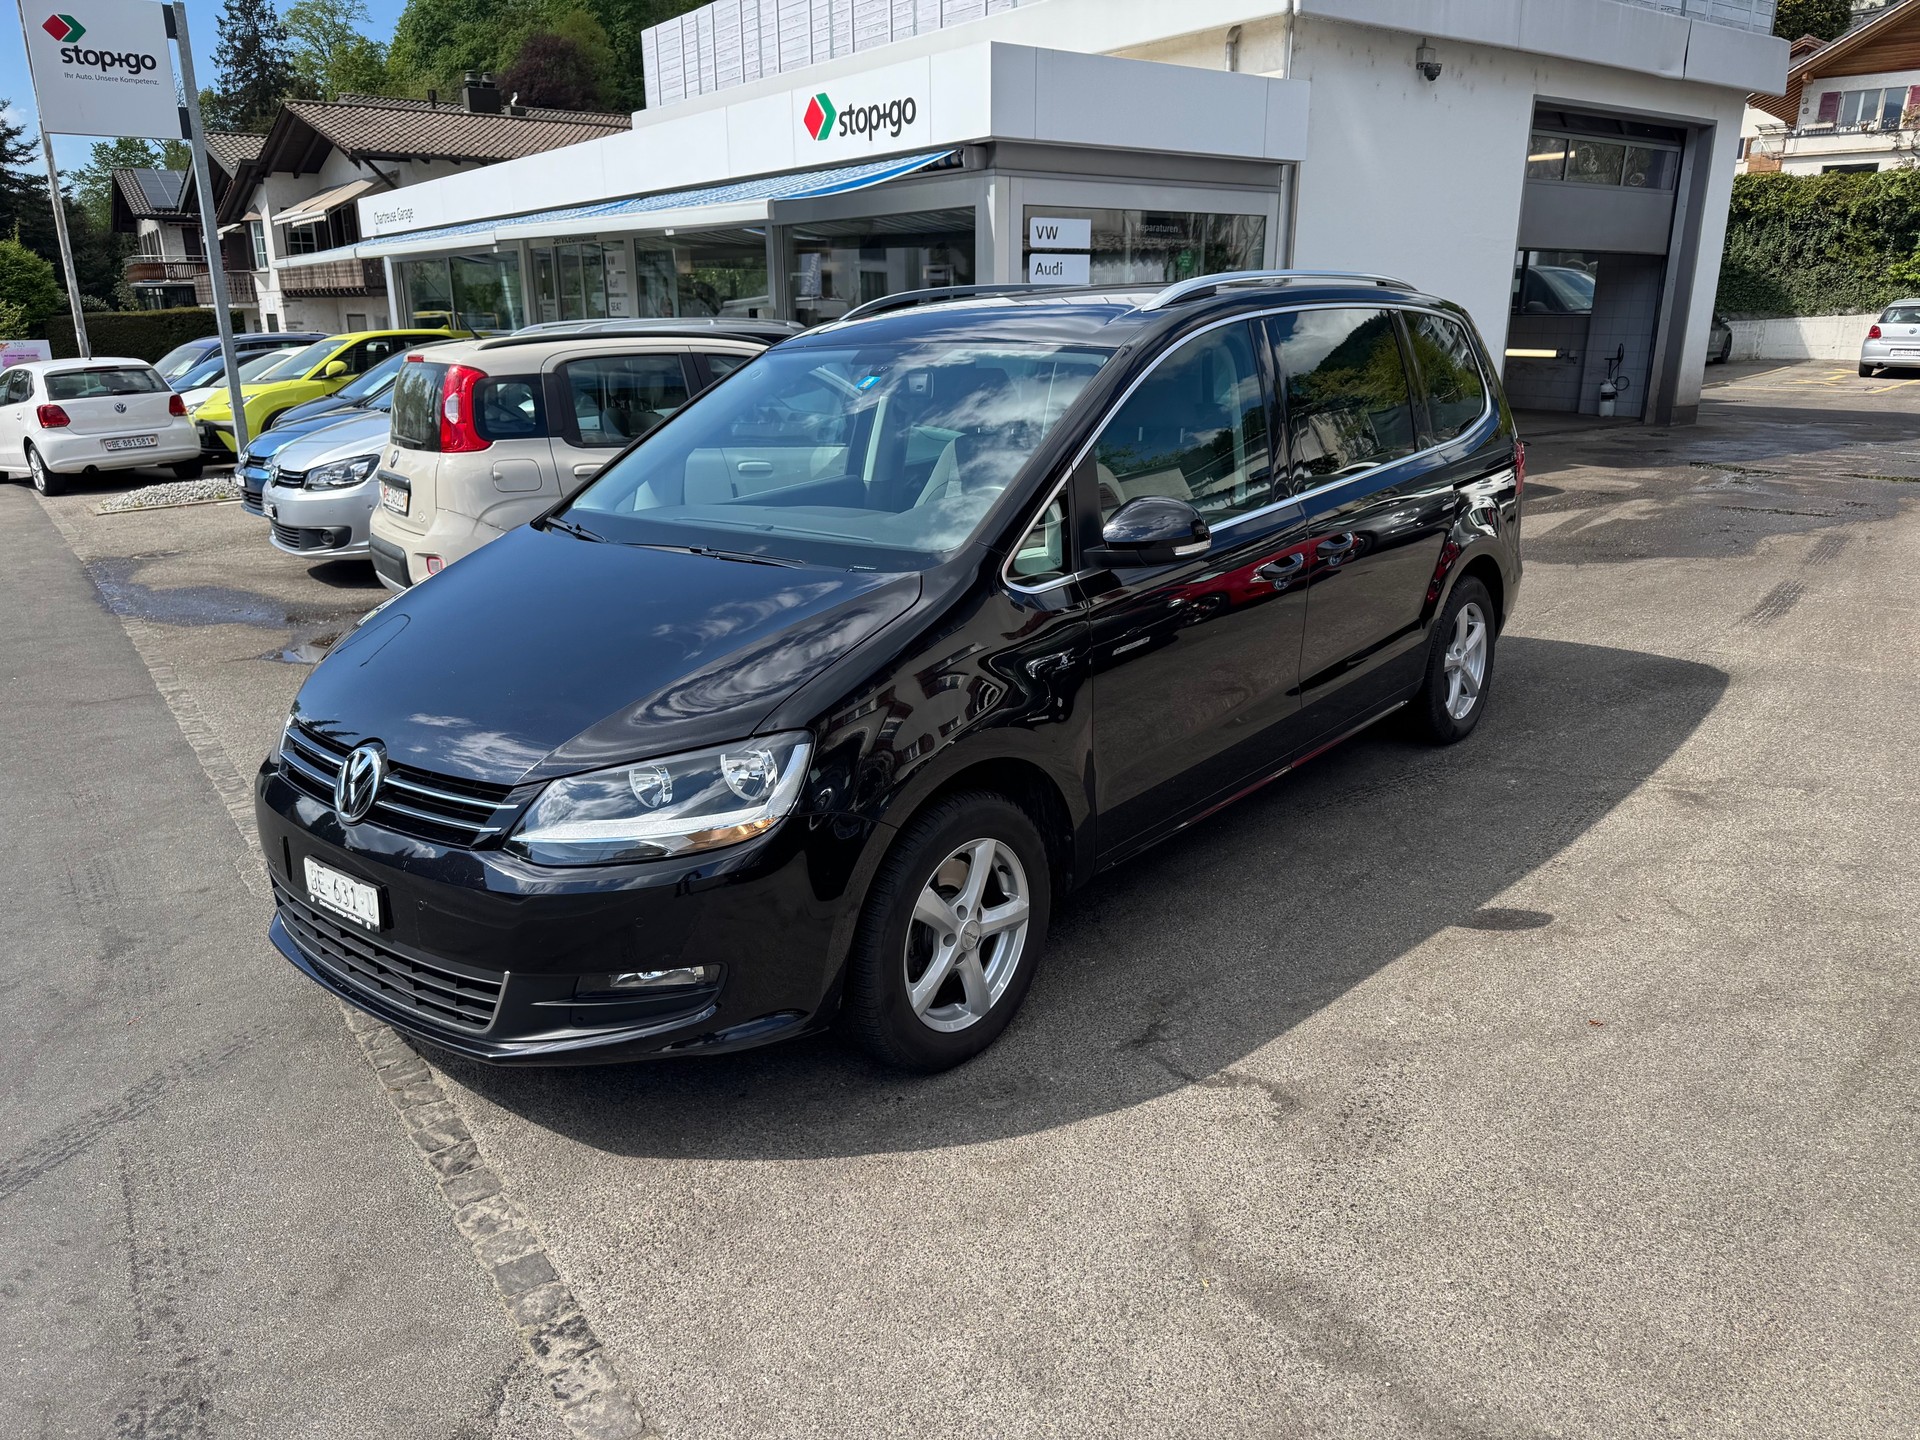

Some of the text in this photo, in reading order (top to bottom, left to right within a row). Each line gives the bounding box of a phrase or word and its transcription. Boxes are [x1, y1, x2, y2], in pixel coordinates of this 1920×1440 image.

[60, 45, 156, 74] stop+go
[75, 73, 94, 81] Auto.
[94, 74, 119, 83] Unsere
[119, 76, 160, 86] Kompetenz.
[839, 97, 916, 141] stop+go
[397, 207, 414, 223] Garage
[1035, 225, 1059, 240] VW
[1135, 222, 1180, 234] Reparaturen
[1034, 261, 1063, 276] Audi
